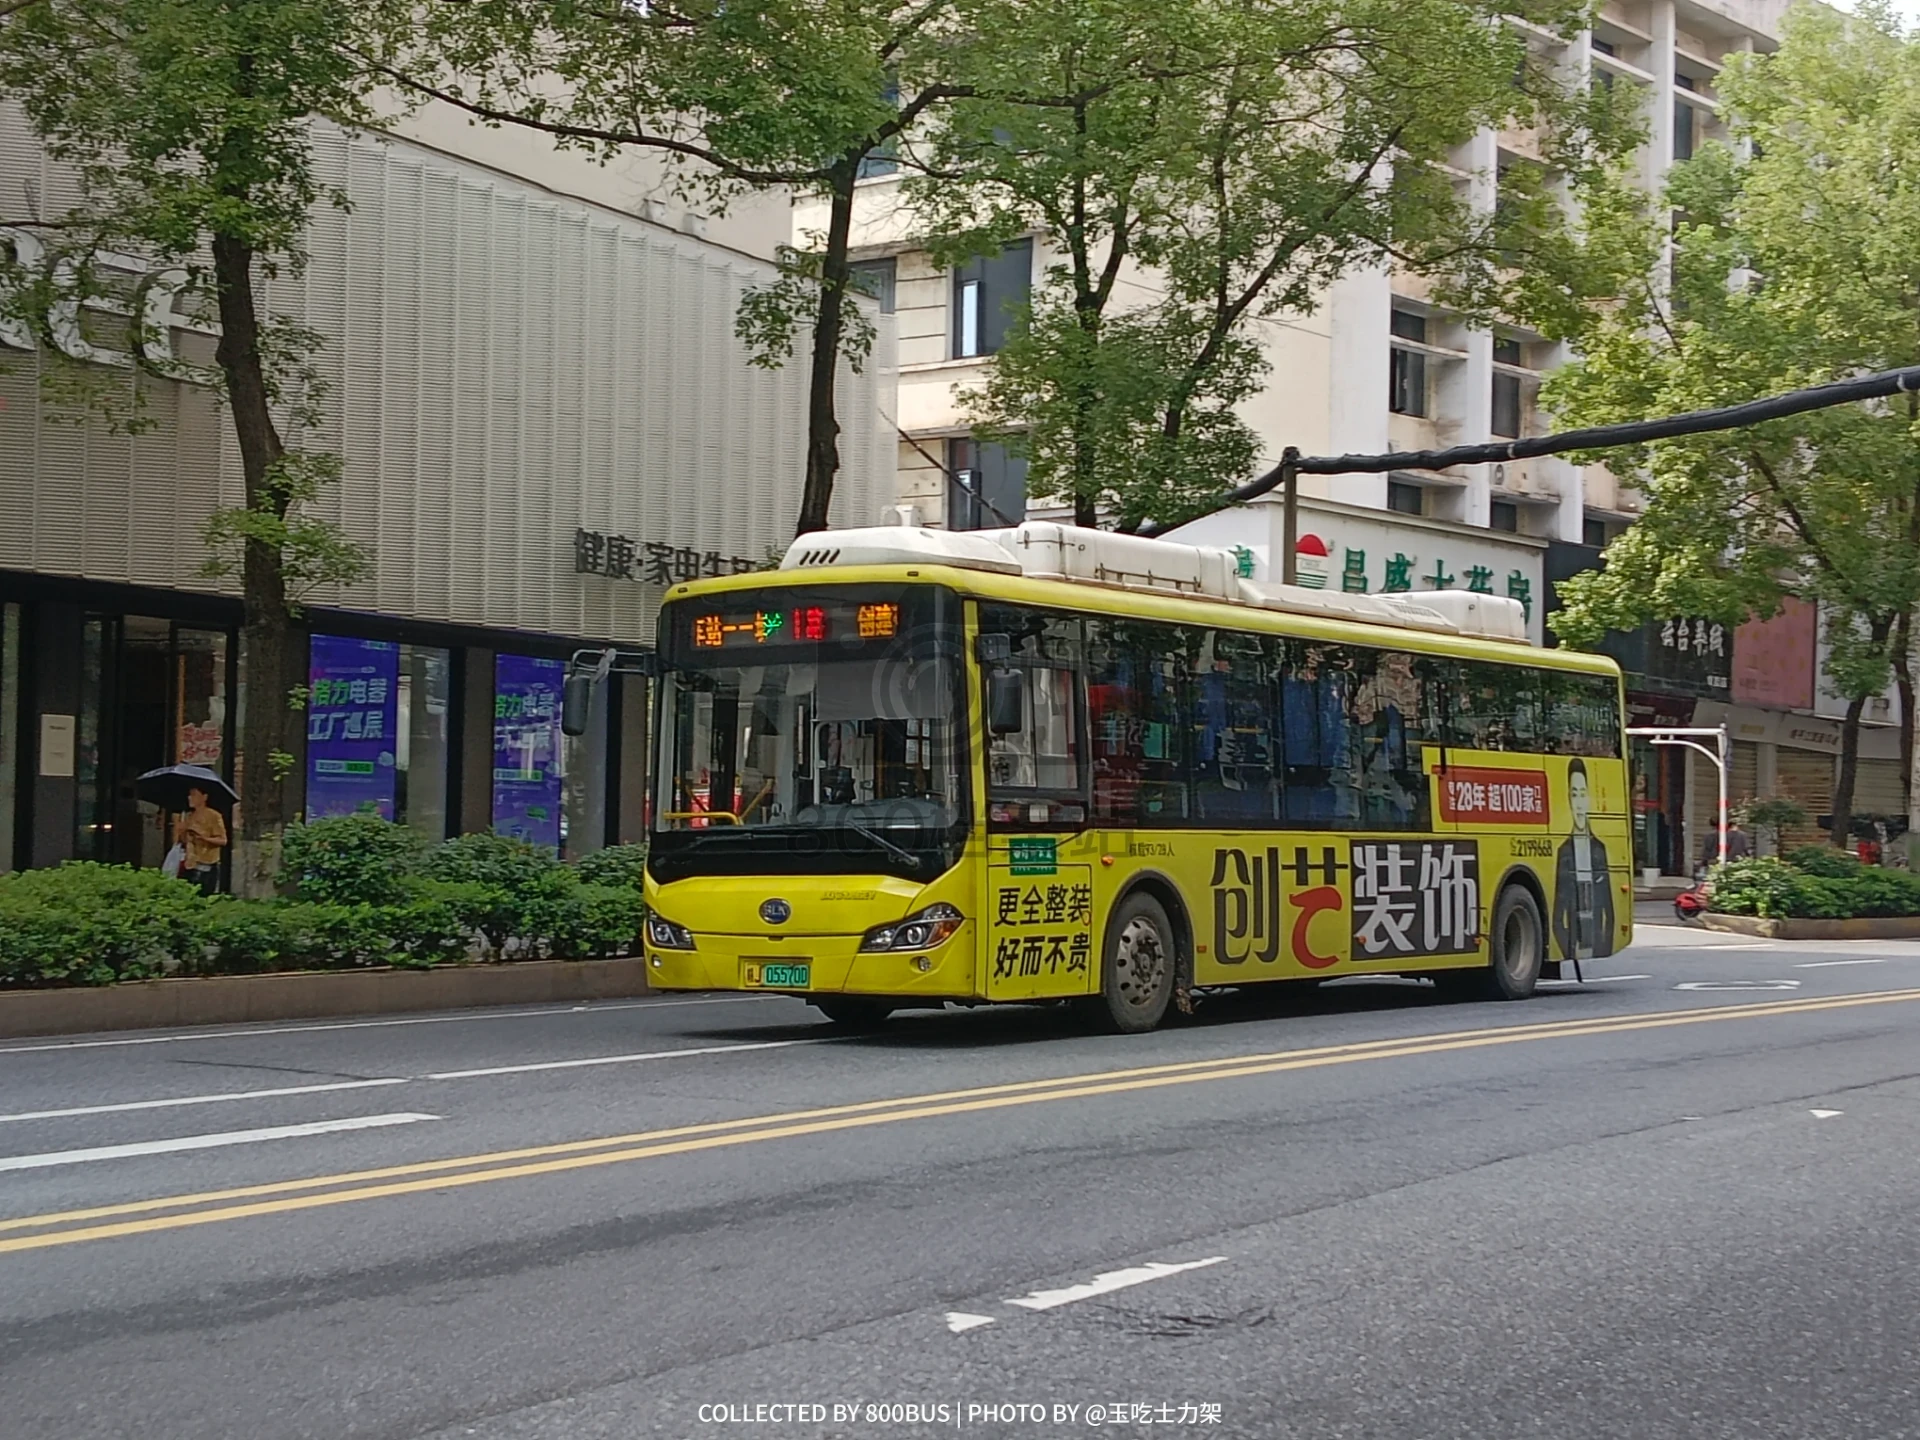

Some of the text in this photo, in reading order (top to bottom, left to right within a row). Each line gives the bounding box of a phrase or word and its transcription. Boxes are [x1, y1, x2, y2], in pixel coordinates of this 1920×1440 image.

[994, 884, 1091, 927] 更全整装
[1210, 844, 1479, 969] 创艺装饰
[993, 932, 1090, 979] 好而不贵
